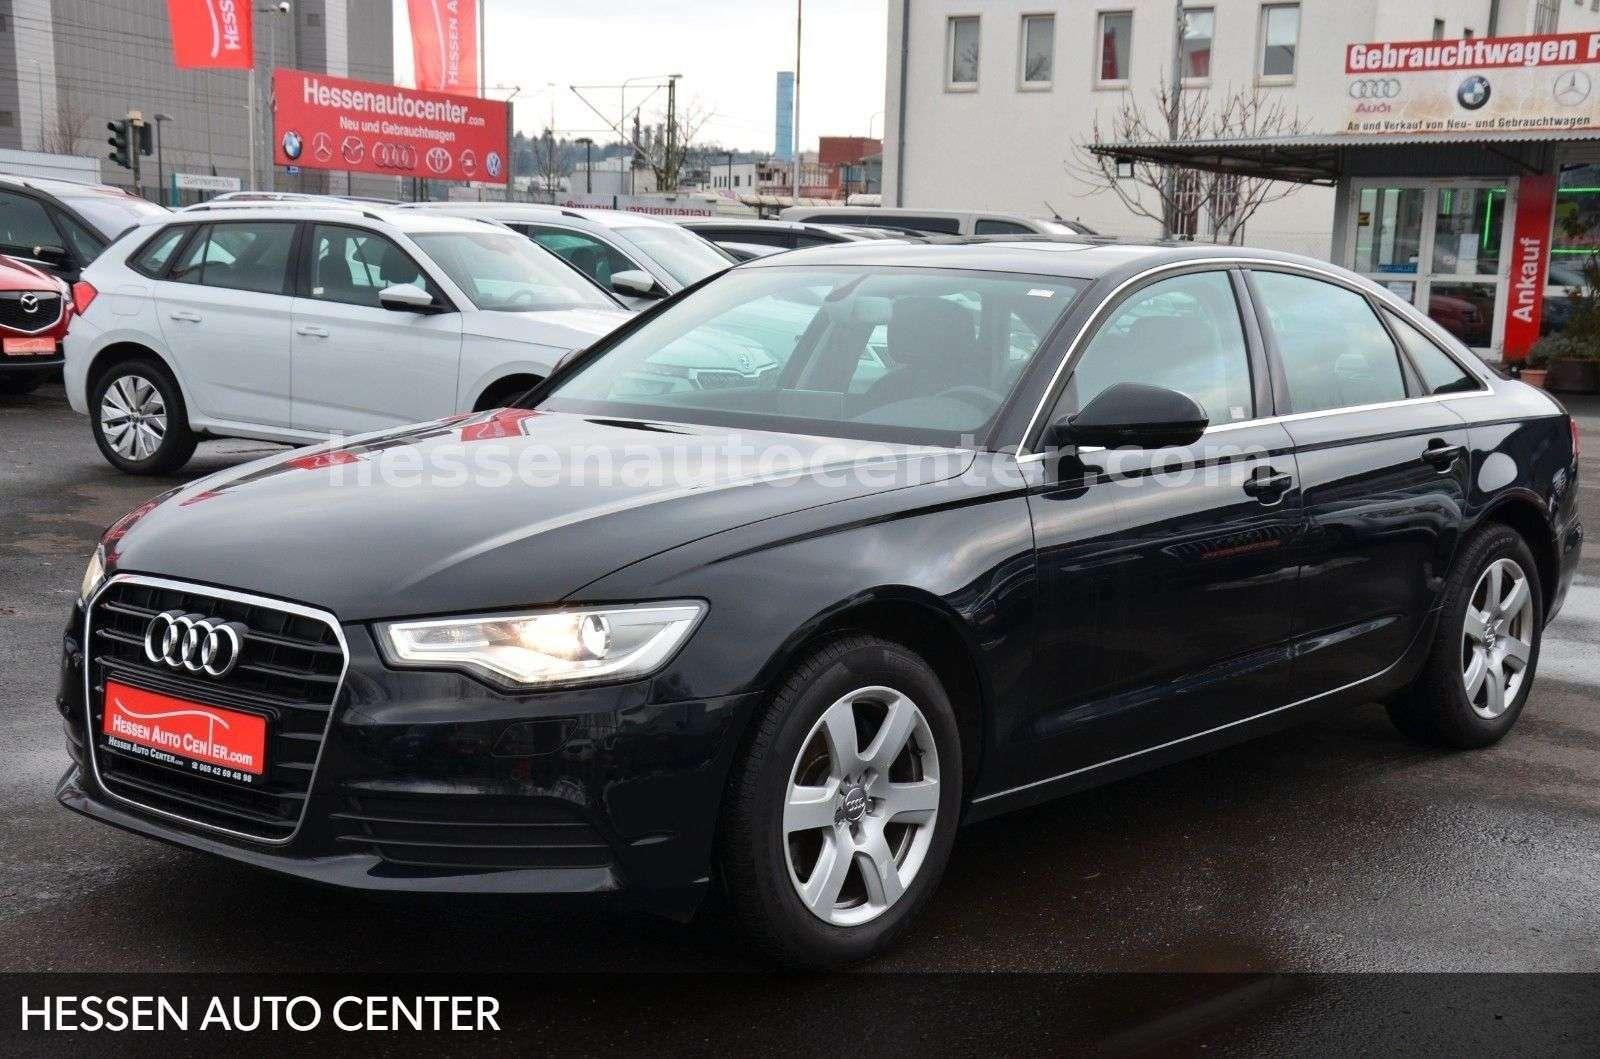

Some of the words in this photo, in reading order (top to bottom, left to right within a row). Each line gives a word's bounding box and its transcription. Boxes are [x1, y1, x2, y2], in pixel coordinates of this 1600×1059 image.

[447, 17, 460, 85] HESSEN
[1350, 38, 1577, 70] Gebrauchtwagen
[303, 77, 485, 126] Hessenautocenter.com
[340, 115, 361, 130] Neu
[362, 117, 381, 133] und
[381, 119, 456, 143] Gebrauchtwagen
[1363, 121, 1381, 131] und
[1384, 119, 1424, 130] Verkauf
[1426, 121, 1444, 130] von
[1475, 118, 1495, 129] und
[1498, 116, 1591, 129] Gebrauchtwagen
[1512, 237, 1541, 323] Ankauf
[212, 767, 222, 777] 42
